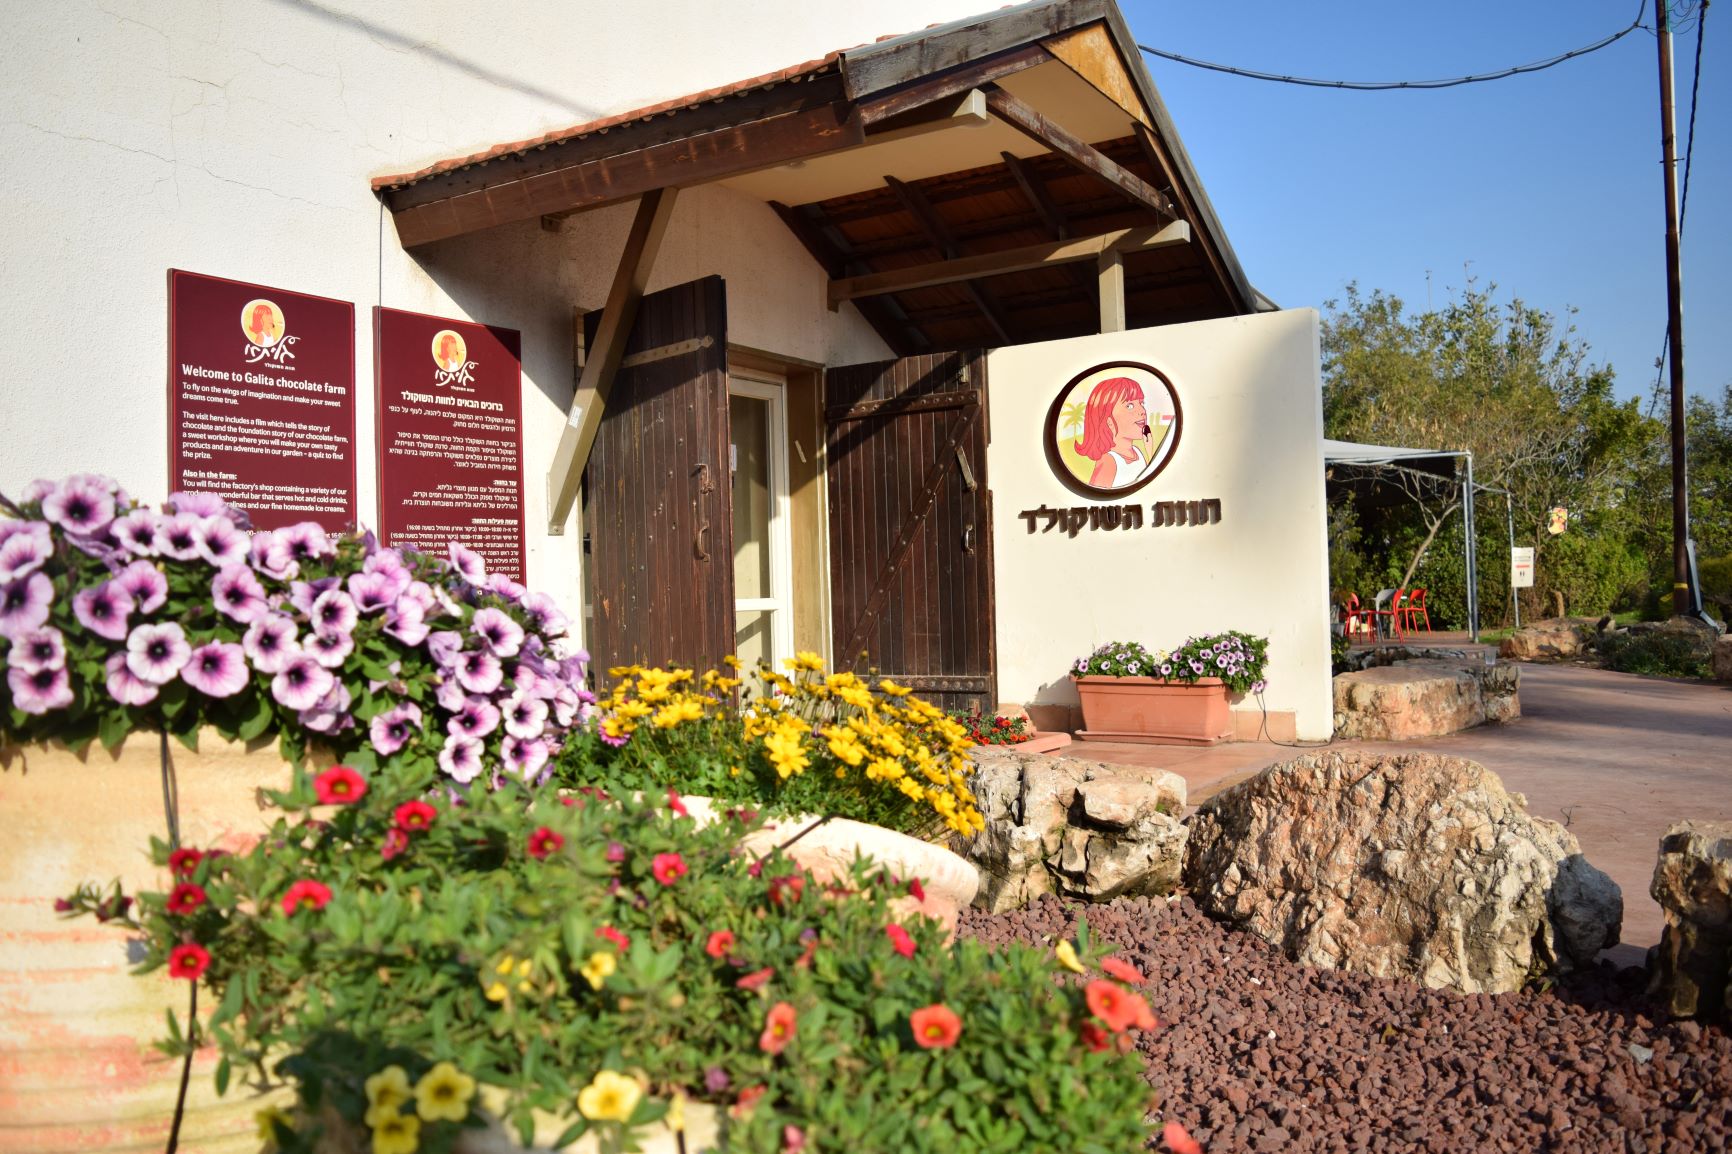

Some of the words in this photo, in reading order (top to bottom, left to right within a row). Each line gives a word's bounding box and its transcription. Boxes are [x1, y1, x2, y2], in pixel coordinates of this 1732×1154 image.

[182, 364, 230, 381] Welcome
[232, 372, 243, 382] to
[244, 372, 274, 386] Galita
[276, 377, 322, 392] chocolate
[324, 382, 346, 395] farm
[182, 382, 192, 390] To
[192, 383, 200, 392] fly
[210, 386, 221, 394] the
[222, 388, 240, 397] wings
[248, 390, 282, 400] imagination
[294, 396, 310, 404] make
[182, 392, 206, 401] dreams
[224, 397, 239, 405] true.
[401, 390, 434, 403] השוקולד
[435, 396, 456, 406] לחוות
[457, 398, 480, 408] הבאים
[480, 401, 503, 411] ברוכים
[183, 411, 195, 419] The
[209, 414, 224, 422] here
[225, 416, 250, 425] includes
[255, 418, 267, 426] film
[267, 420, 284, 428] which
[285, 422, 297, 430] tells
[308, 425, 323, 433] story
[182, 421, 214, 431] chocolate
[227, 425, 238, 433] the
[238, 426, 271, 436] foundation
[271, 430, 287, 439] story
[305, 432, 334, 442] chocolate
[334, 435, 348, 443] farm,
[188, 432, 206, 440] sweet
[207, 434, 238, 443] workshop
[238, 436, 257, 444] where
[270, 438, 280, 446] will
[323, 444, 338, 452] tasty
[182, 442, 211, 450] products
[233, 445, 264, 454] adventure
[312, 451, 324, 459] quiz
[332, 452, 344, 460] find
[182, 450, 194, 458] the
[194, 451, 212, 459] prize.
[183, 469, 198, 477] Also
[198, 470, 206, 478] in
[206, 471, 218, 479] the
[219, 472, 237, 480] farm:
[183, 479, 196, 487] You
[207, 480, 220, 488] find
[220, 481, 232, 489] the
[232, 482, 259, 492] factory's
[259, 484, 274, 493] shop
[274, 486, 305, 495] containing
[310, 487, 330, 496] variety
[219, 491, 250, 500] wonderful
[250, 492, 261, 500] bar
[294, 494, 305, 502] hot
[283, 503, 315, 511] homemade
[1152, 498, 1222, 528] חוות
[1018, 503, 1144, 539] השוקולד
